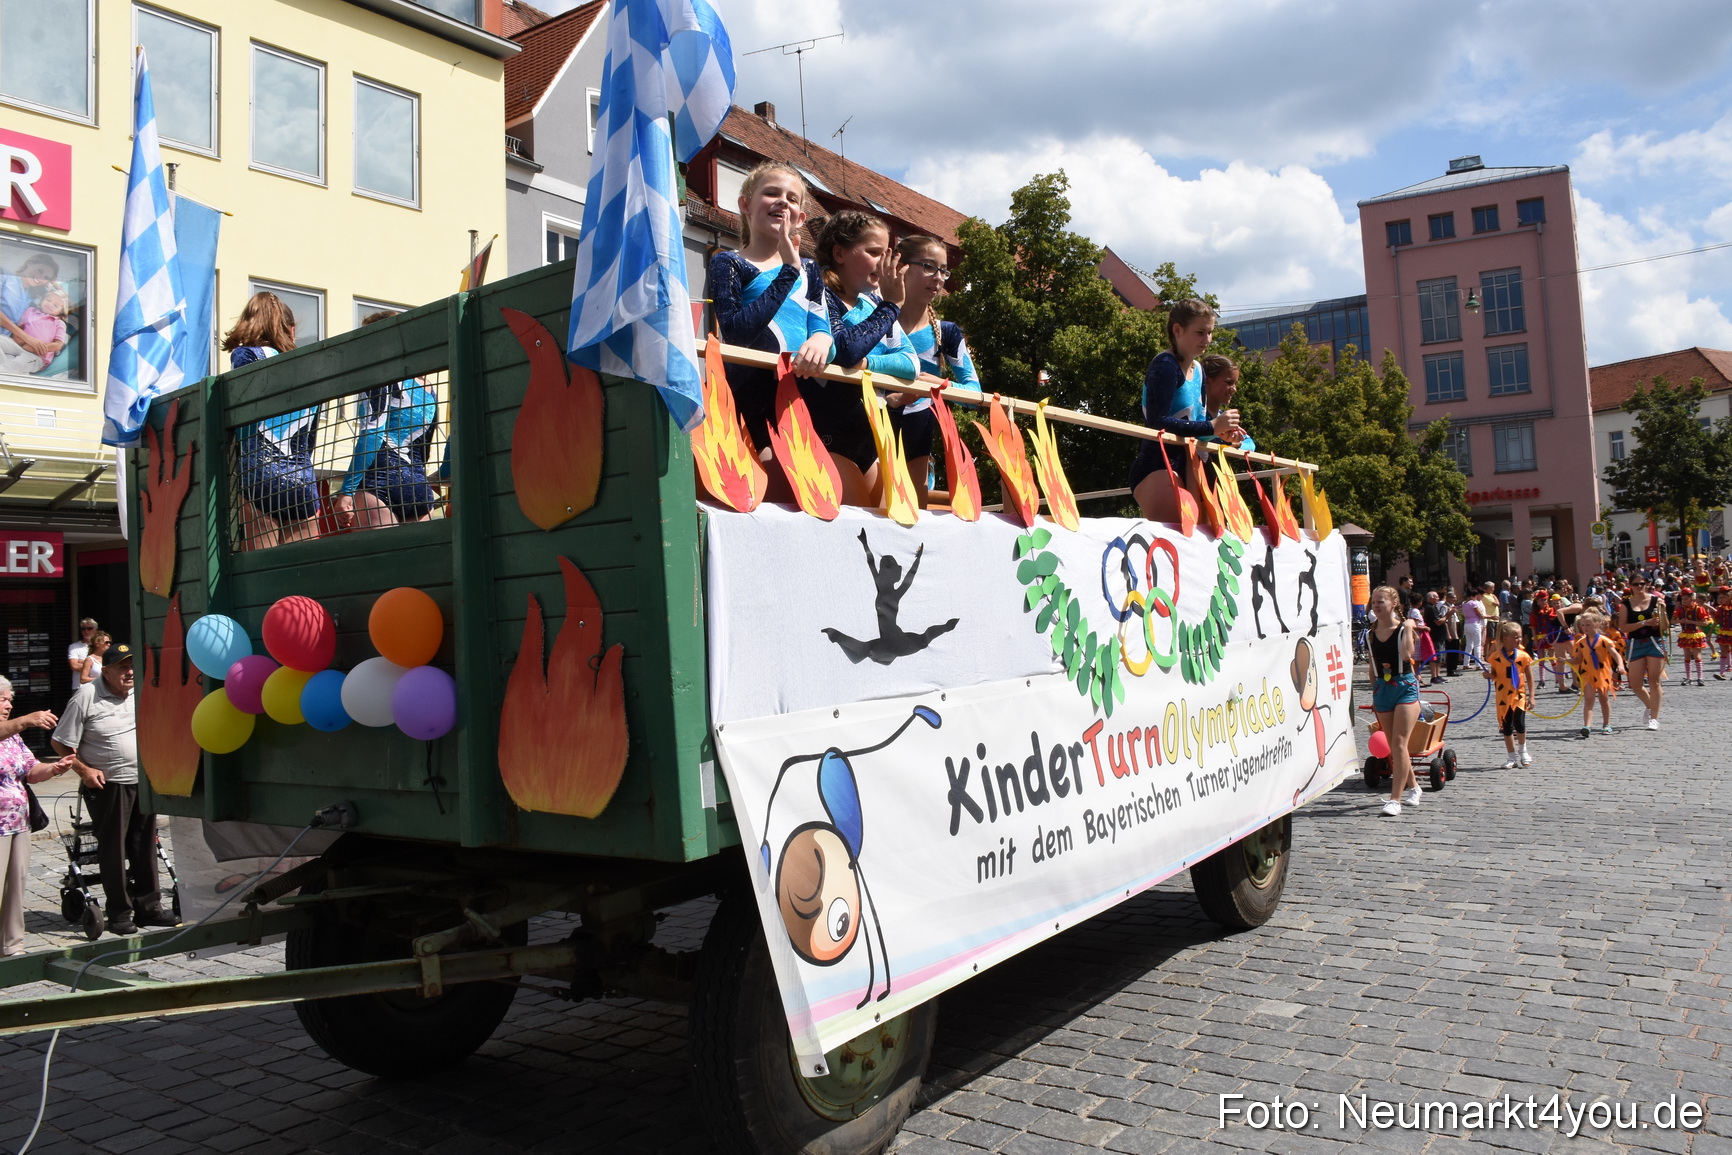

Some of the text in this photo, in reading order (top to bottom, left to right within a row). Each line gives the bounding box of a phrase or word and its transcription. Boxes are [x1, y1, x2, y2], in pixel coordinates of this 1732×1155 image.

[1463, 487, 1540, 505] Sparkasse
[0, 540, 56, 573] ER
[977, 837, 1016, 883] mit
[1032, 825, 1073, 863] dem
[1083, 783, 1182, 844] Bayerischen
